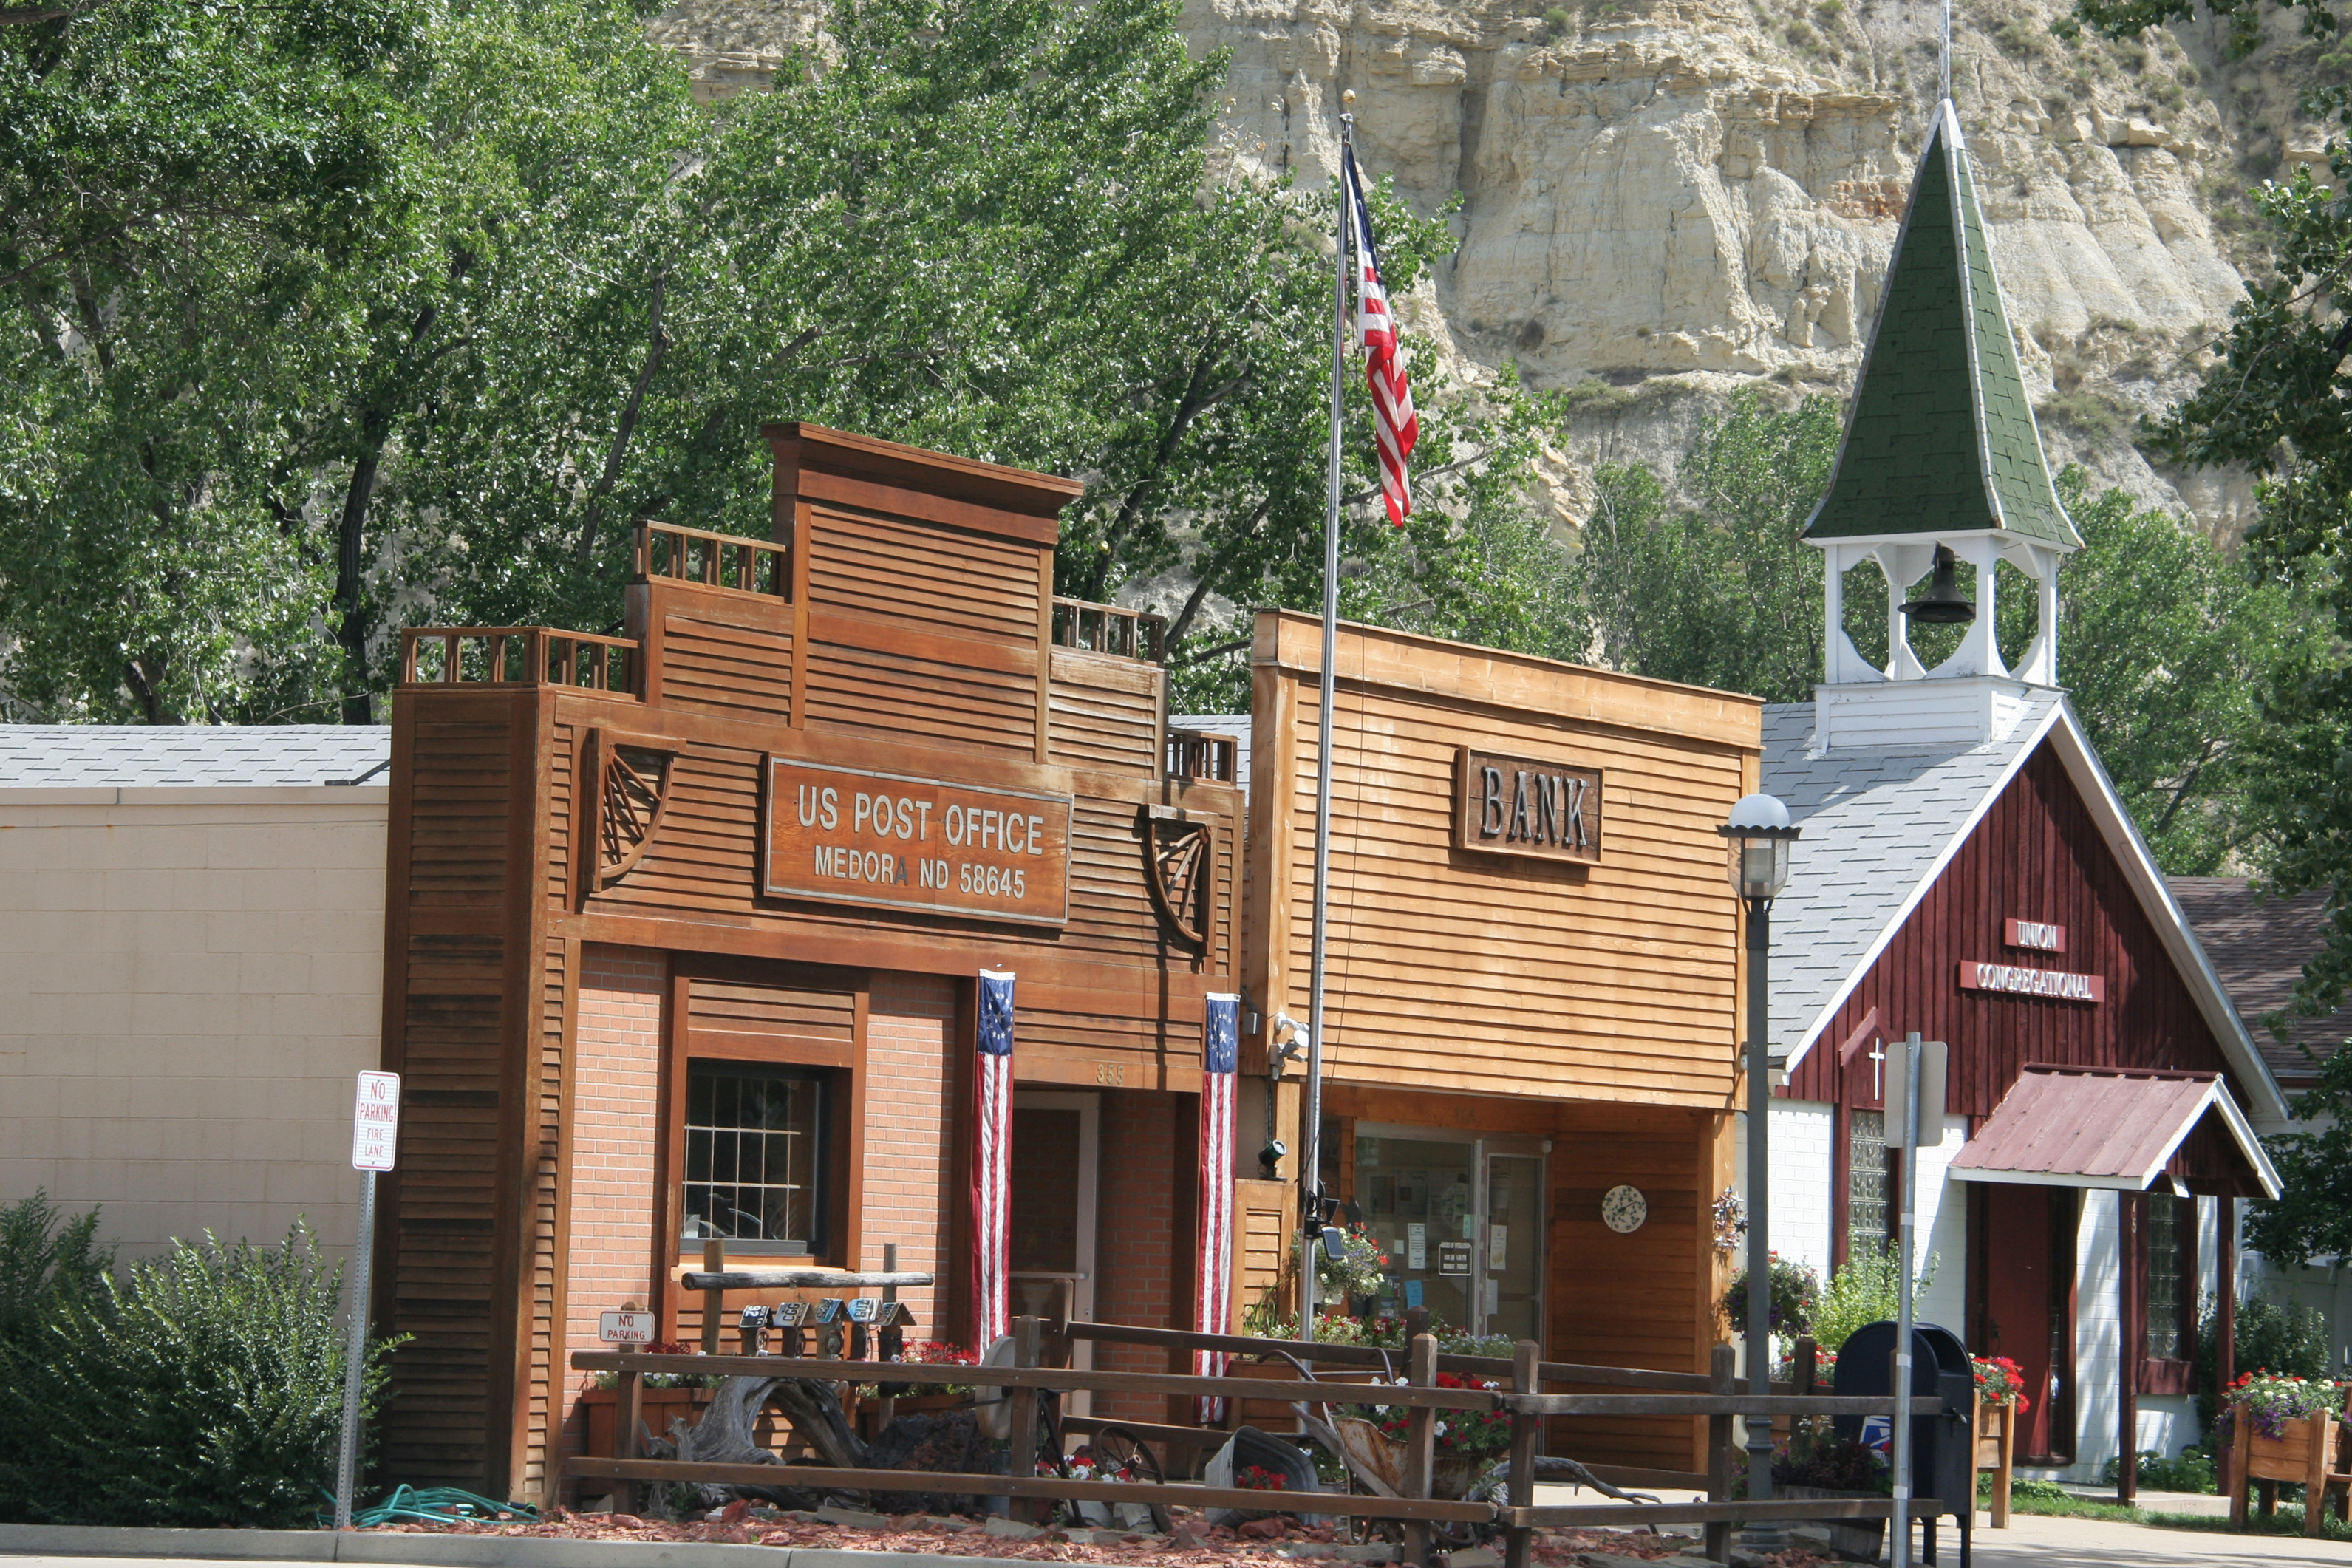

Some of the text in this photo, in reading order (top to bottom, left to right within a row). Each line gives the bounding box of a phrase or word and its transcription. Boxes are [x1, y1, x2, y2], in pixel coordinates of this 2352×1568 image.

[1482, 766, 1587, 846] BANK
[798, 784, 1043, 855] US POST OFFICE
[814, 845, 1026, 899] MEDORA ND 58645
[2017, 921, 2057, 950] UNION
[1976, 963, 2093, 999] CONGREGATIONAL
[1097, 1064, 1124, 1085] 355
[371, 1083, 385, 1099] NO
[360, 1104, 394, 1122] PARKING
[367, 1128, 384, 1140] FIRE
[365, 1145, 384, 1156] LANE
[618, 1315, 634, 1327] NO
[607, 1329, 645, 1340] PARKING
